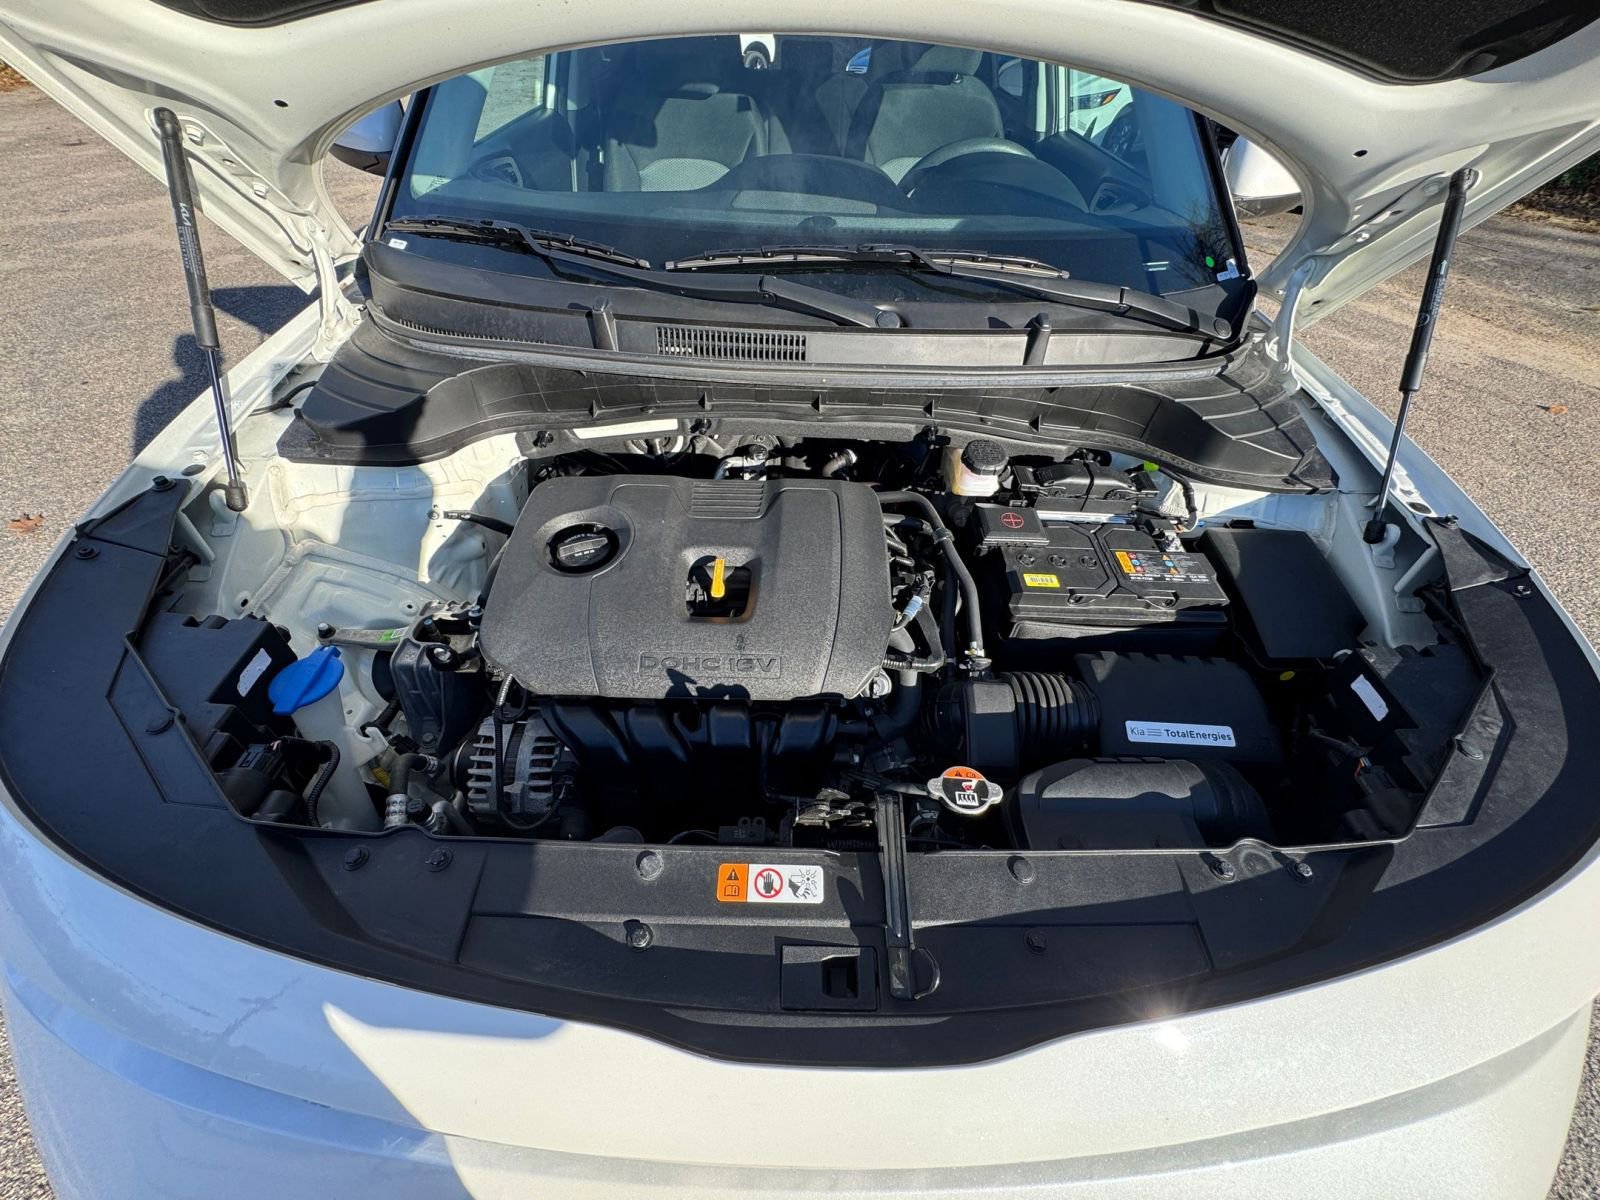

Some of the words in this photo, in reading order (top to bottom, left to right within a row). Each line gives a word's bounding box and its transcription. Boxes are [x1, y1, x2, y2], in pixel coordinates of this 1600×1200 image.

[640, 656, 721, 671] DOHC
[729, 657, 777, 673] 16V
[1130, 726, 1145, 736] Kia
[1164, 728, 1232, 742] TotalEnergies
